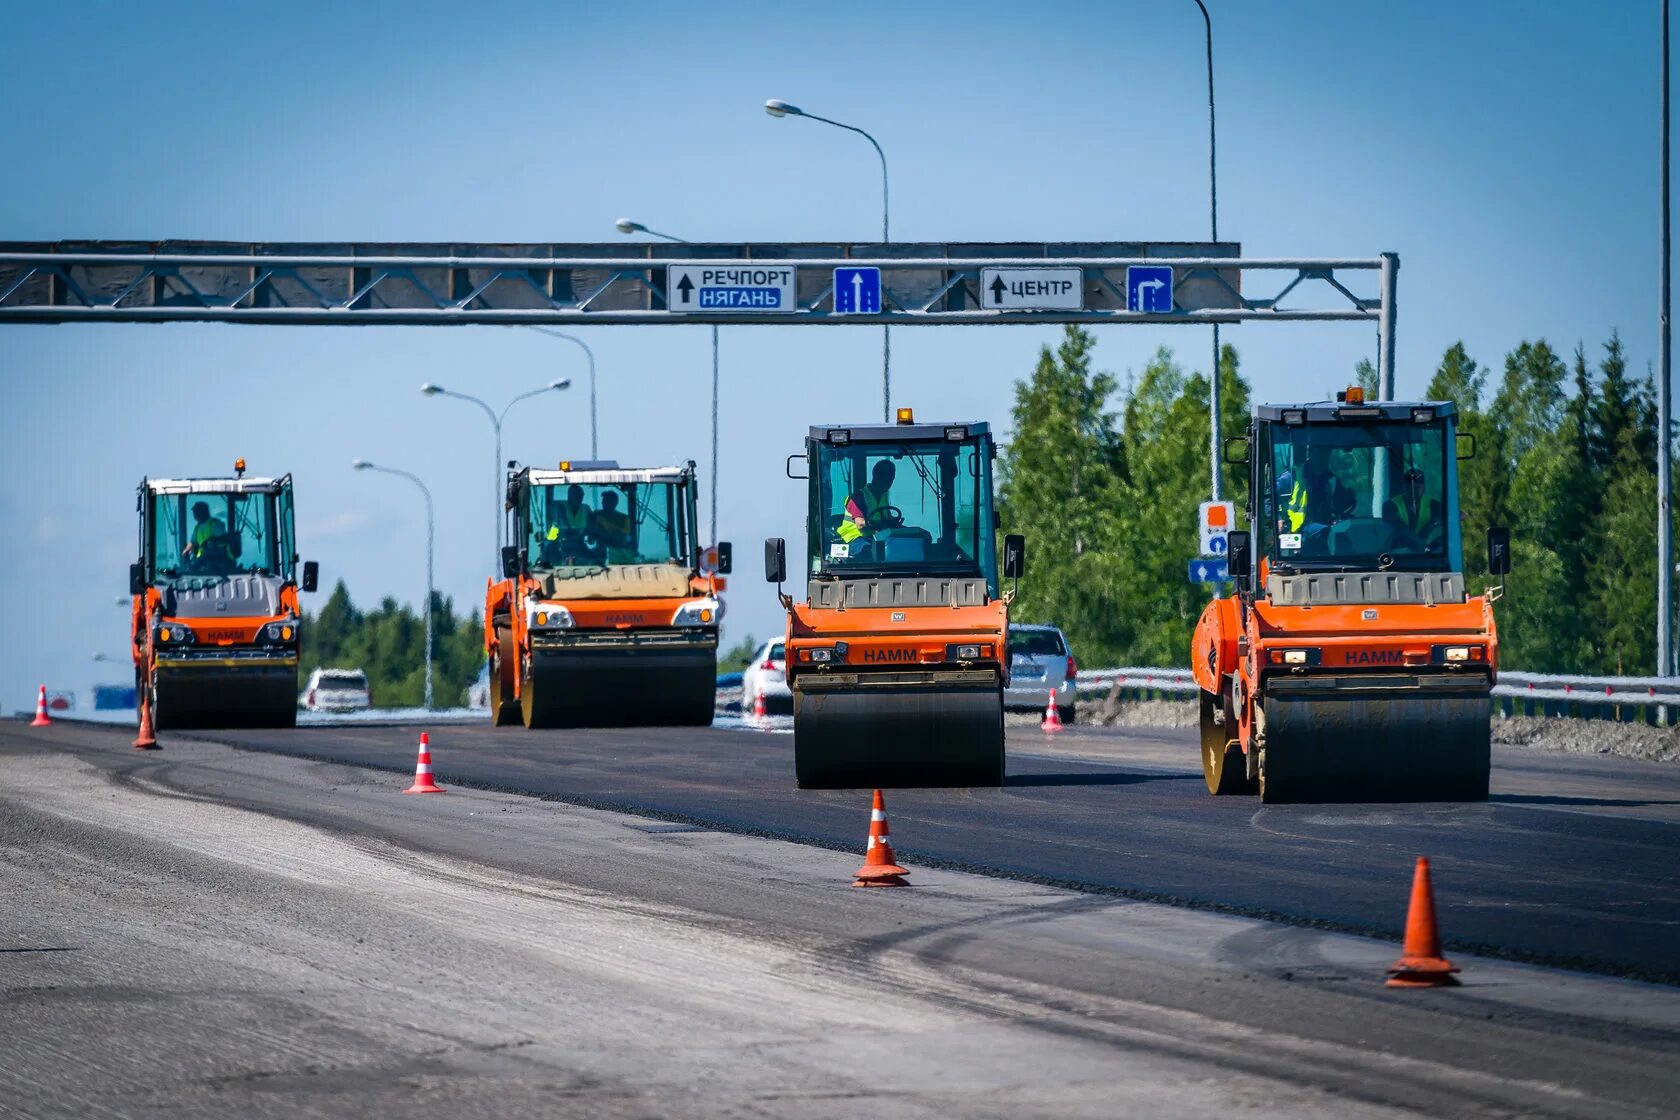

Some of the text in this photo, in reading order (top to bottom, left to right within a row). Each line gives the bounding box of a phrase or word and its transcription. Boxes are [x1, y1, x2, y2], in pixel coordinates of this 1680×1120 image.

[702, 270, 791, 286] РЕЧПОРТ
[1011, 280, 1073, 298] ЦЕНТР
[702, 290, 778, 306] НЯГАНЬ
[208, 631, 245, 641] HAMM
[864, 649, 917, 662] HAMM
[1345, 650, 1403, 664] HAMM
